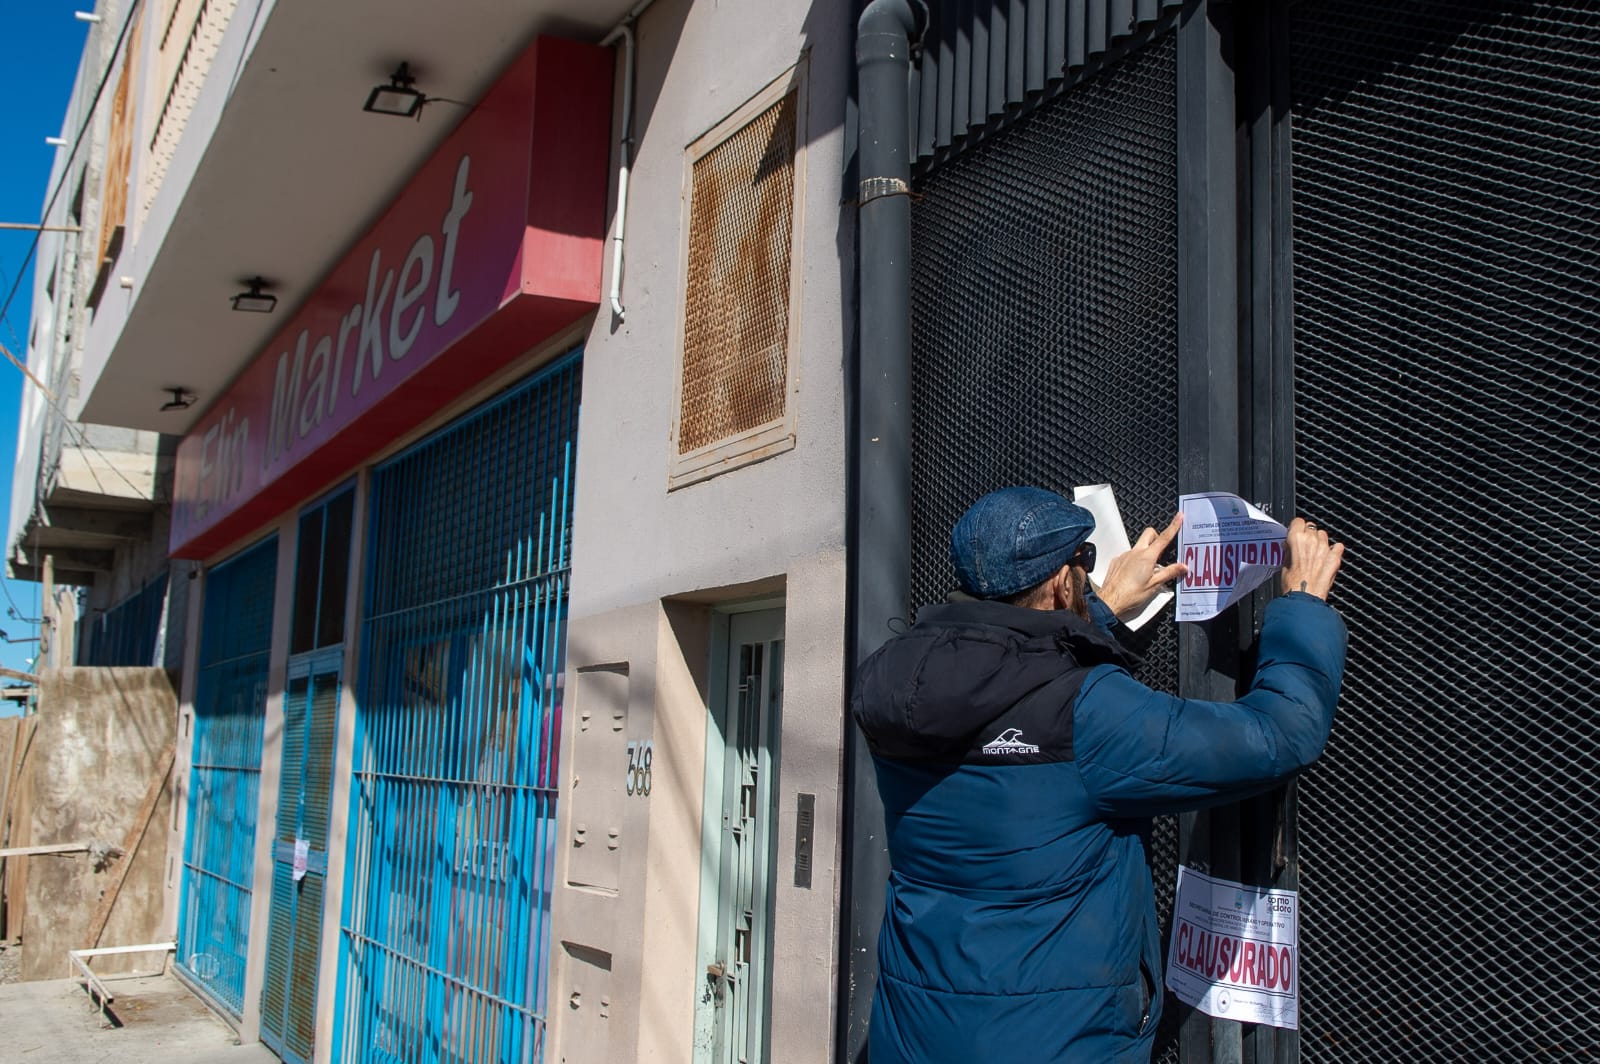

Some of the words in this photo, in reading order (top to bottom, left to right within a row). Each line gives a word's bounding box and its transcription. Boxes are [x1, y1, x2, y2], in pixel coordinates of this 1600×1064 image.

[264, 154, 473, 471] Market
[626, 741, 653, 797] 368
[982, 746, 1041, 755] MONTAGNE
[1178, 922, 1291, 992] CLAUSURADO
